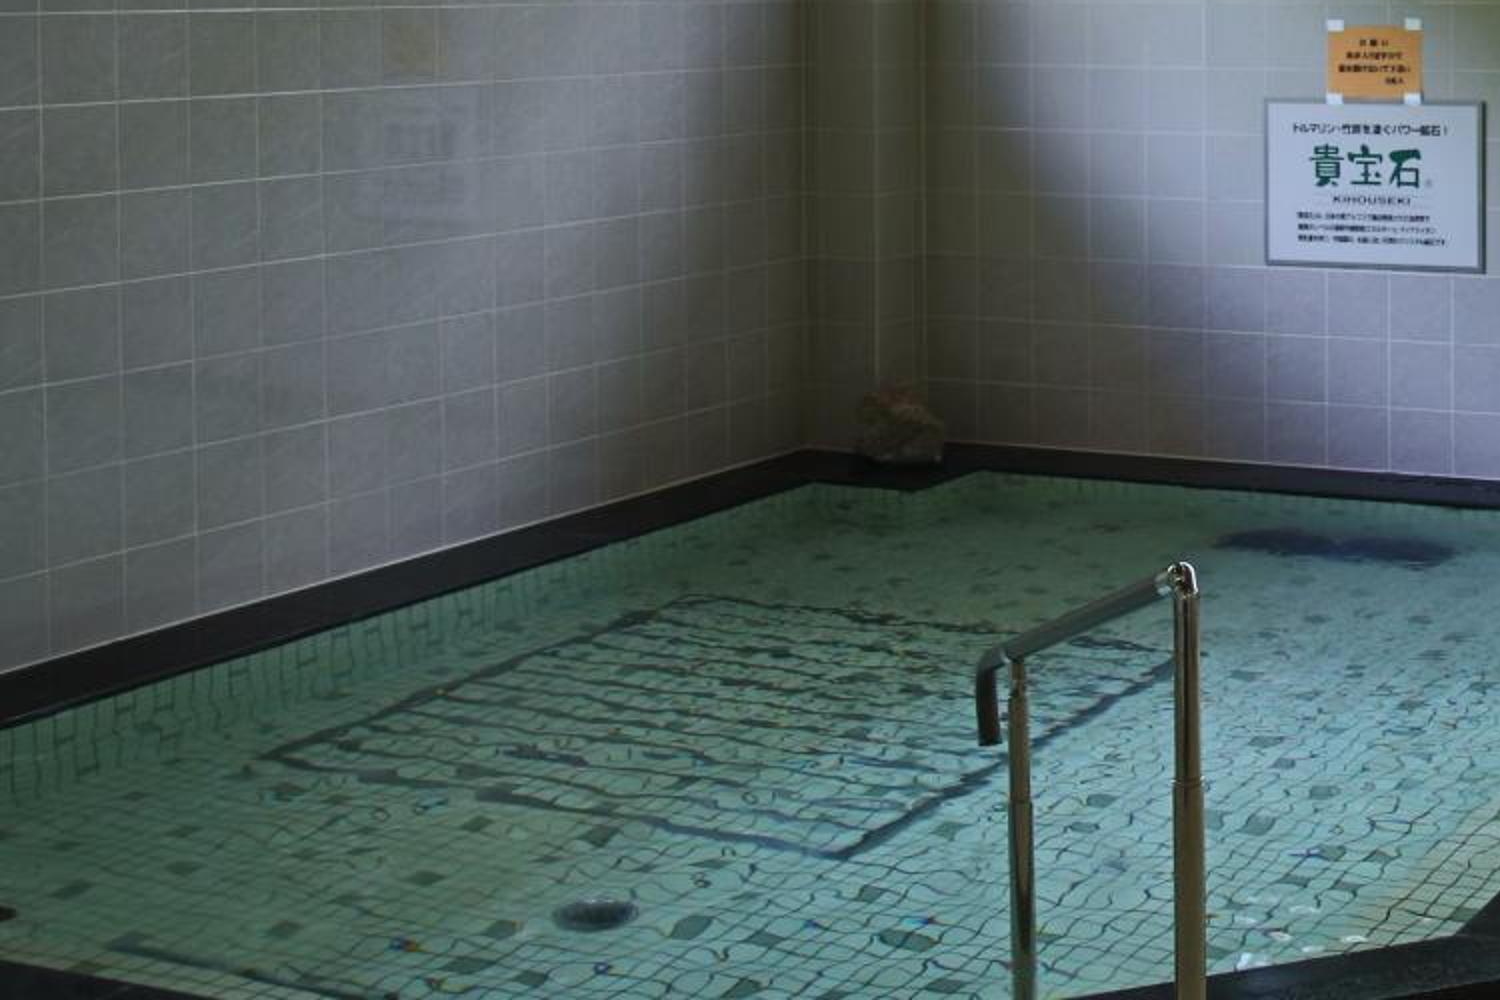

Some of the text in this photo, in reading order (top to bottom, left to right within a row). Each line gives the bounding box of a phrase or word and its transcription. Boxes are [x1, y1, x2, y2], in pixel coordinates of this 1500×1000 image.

[1309, 143, 1422, 189] 貴宝石
[1333, 195, 1411, 206] KIHOUSEKI
